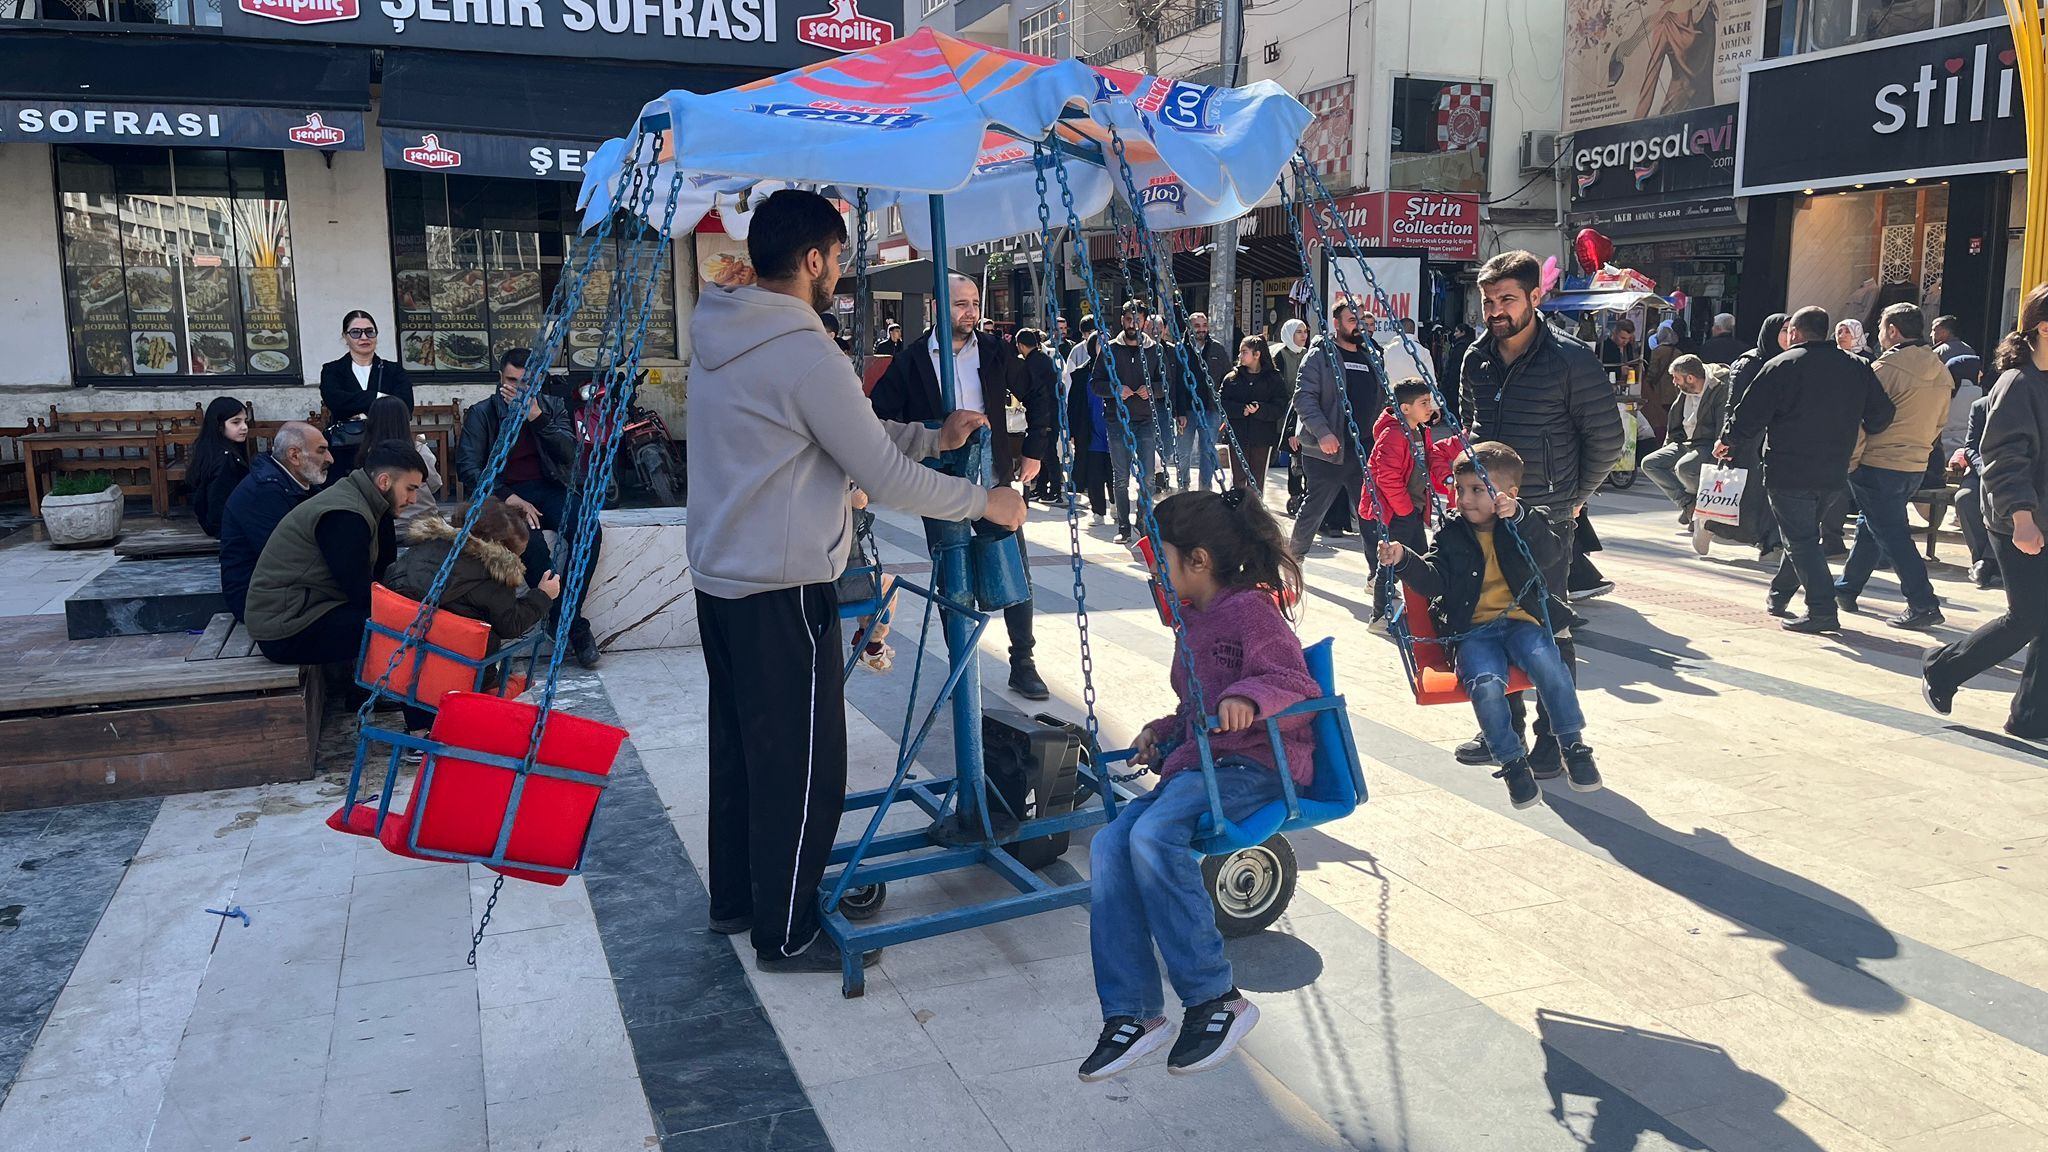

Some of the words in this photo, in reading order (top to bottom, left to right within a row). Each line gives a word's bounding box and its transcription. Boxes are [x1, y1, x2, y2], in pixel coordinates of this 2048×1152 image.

[1721, 21, 1751, 36] AKER
[1718, 49, 1752, 63] SARAR
[1136, 77, 1173, 112] ÜLKE
[18, 108, 220, 137] SOFRASI
[774, 108, 912, 127] Golf
[1575, 115, 1733, 170] esarpsalevi
[1405, 197, 1462, 221] Şirin
[1658, 209, 1681, 219] SARAR
[1392, 218, 1472, 236] Collection
